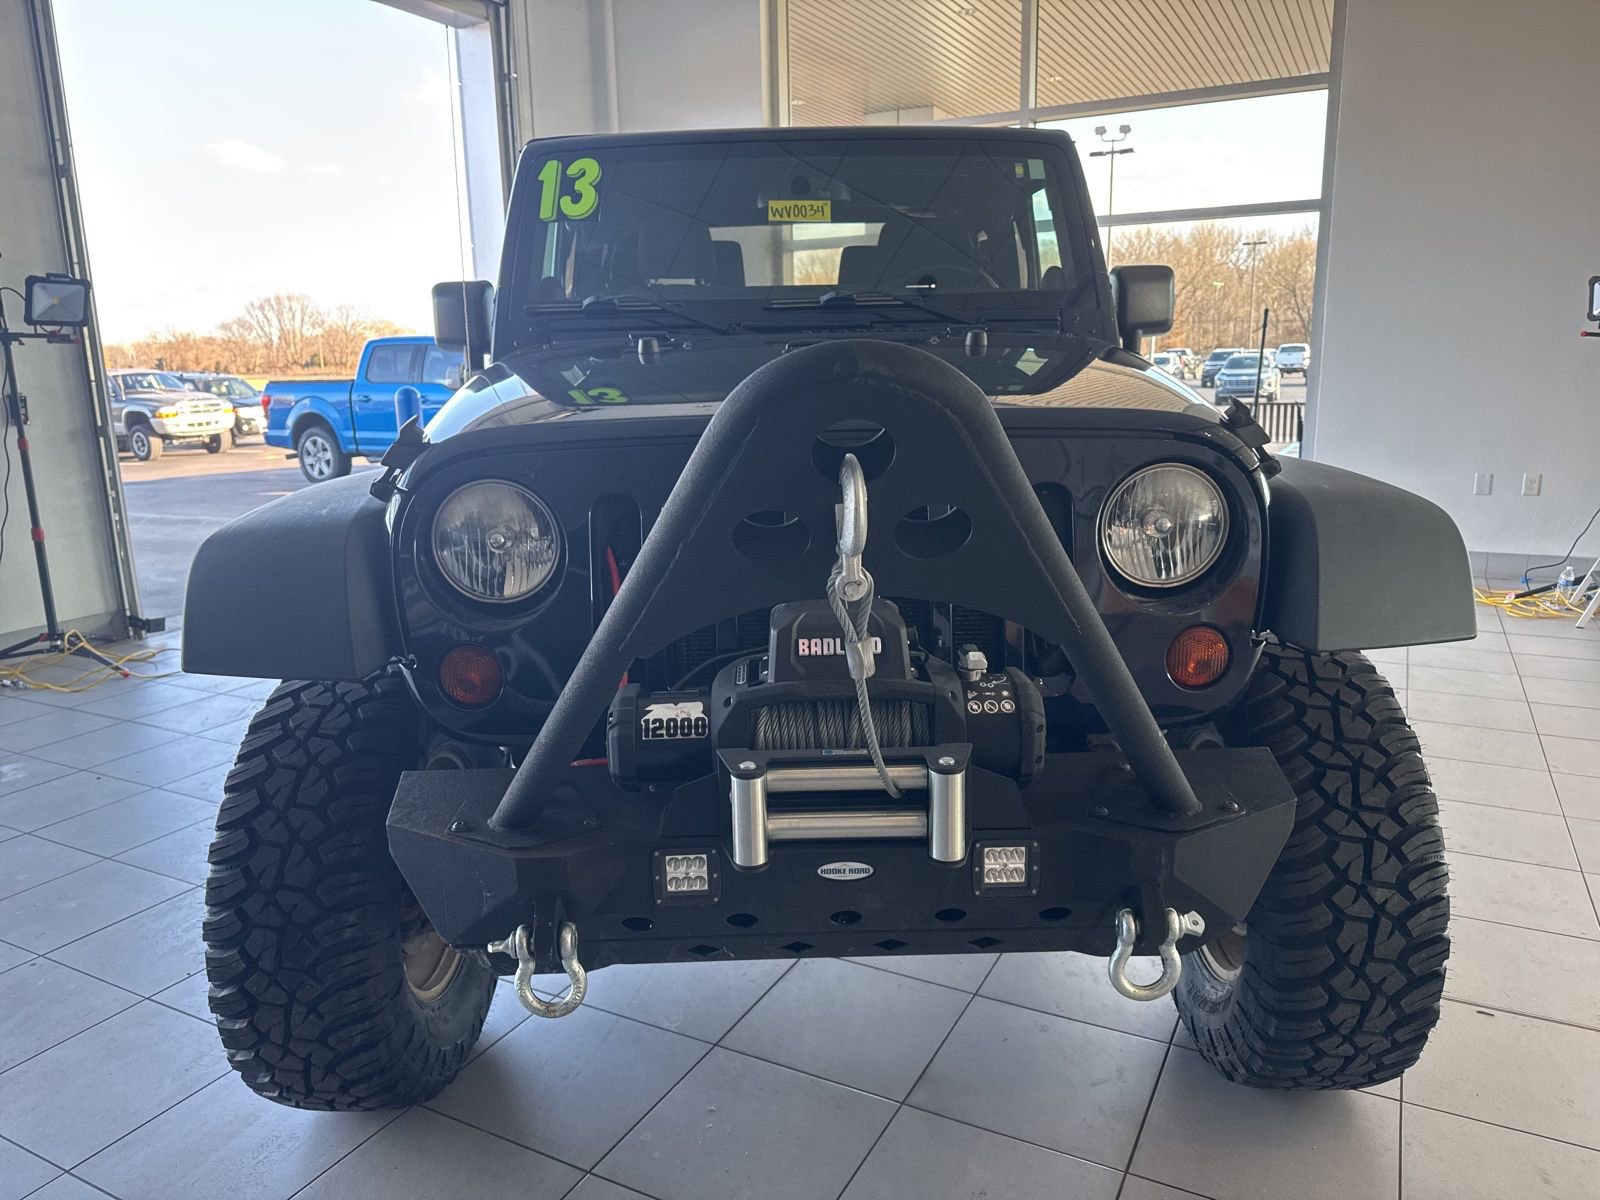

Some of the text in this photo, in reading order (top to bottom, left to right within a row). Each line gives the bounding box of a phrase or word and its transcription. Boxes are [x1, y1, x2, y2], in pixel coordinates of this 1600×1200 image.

[538, 157, 602, 221] 13
[798, 637, 882, 656] BADLD
[642, 717, 706, 738] 12000
